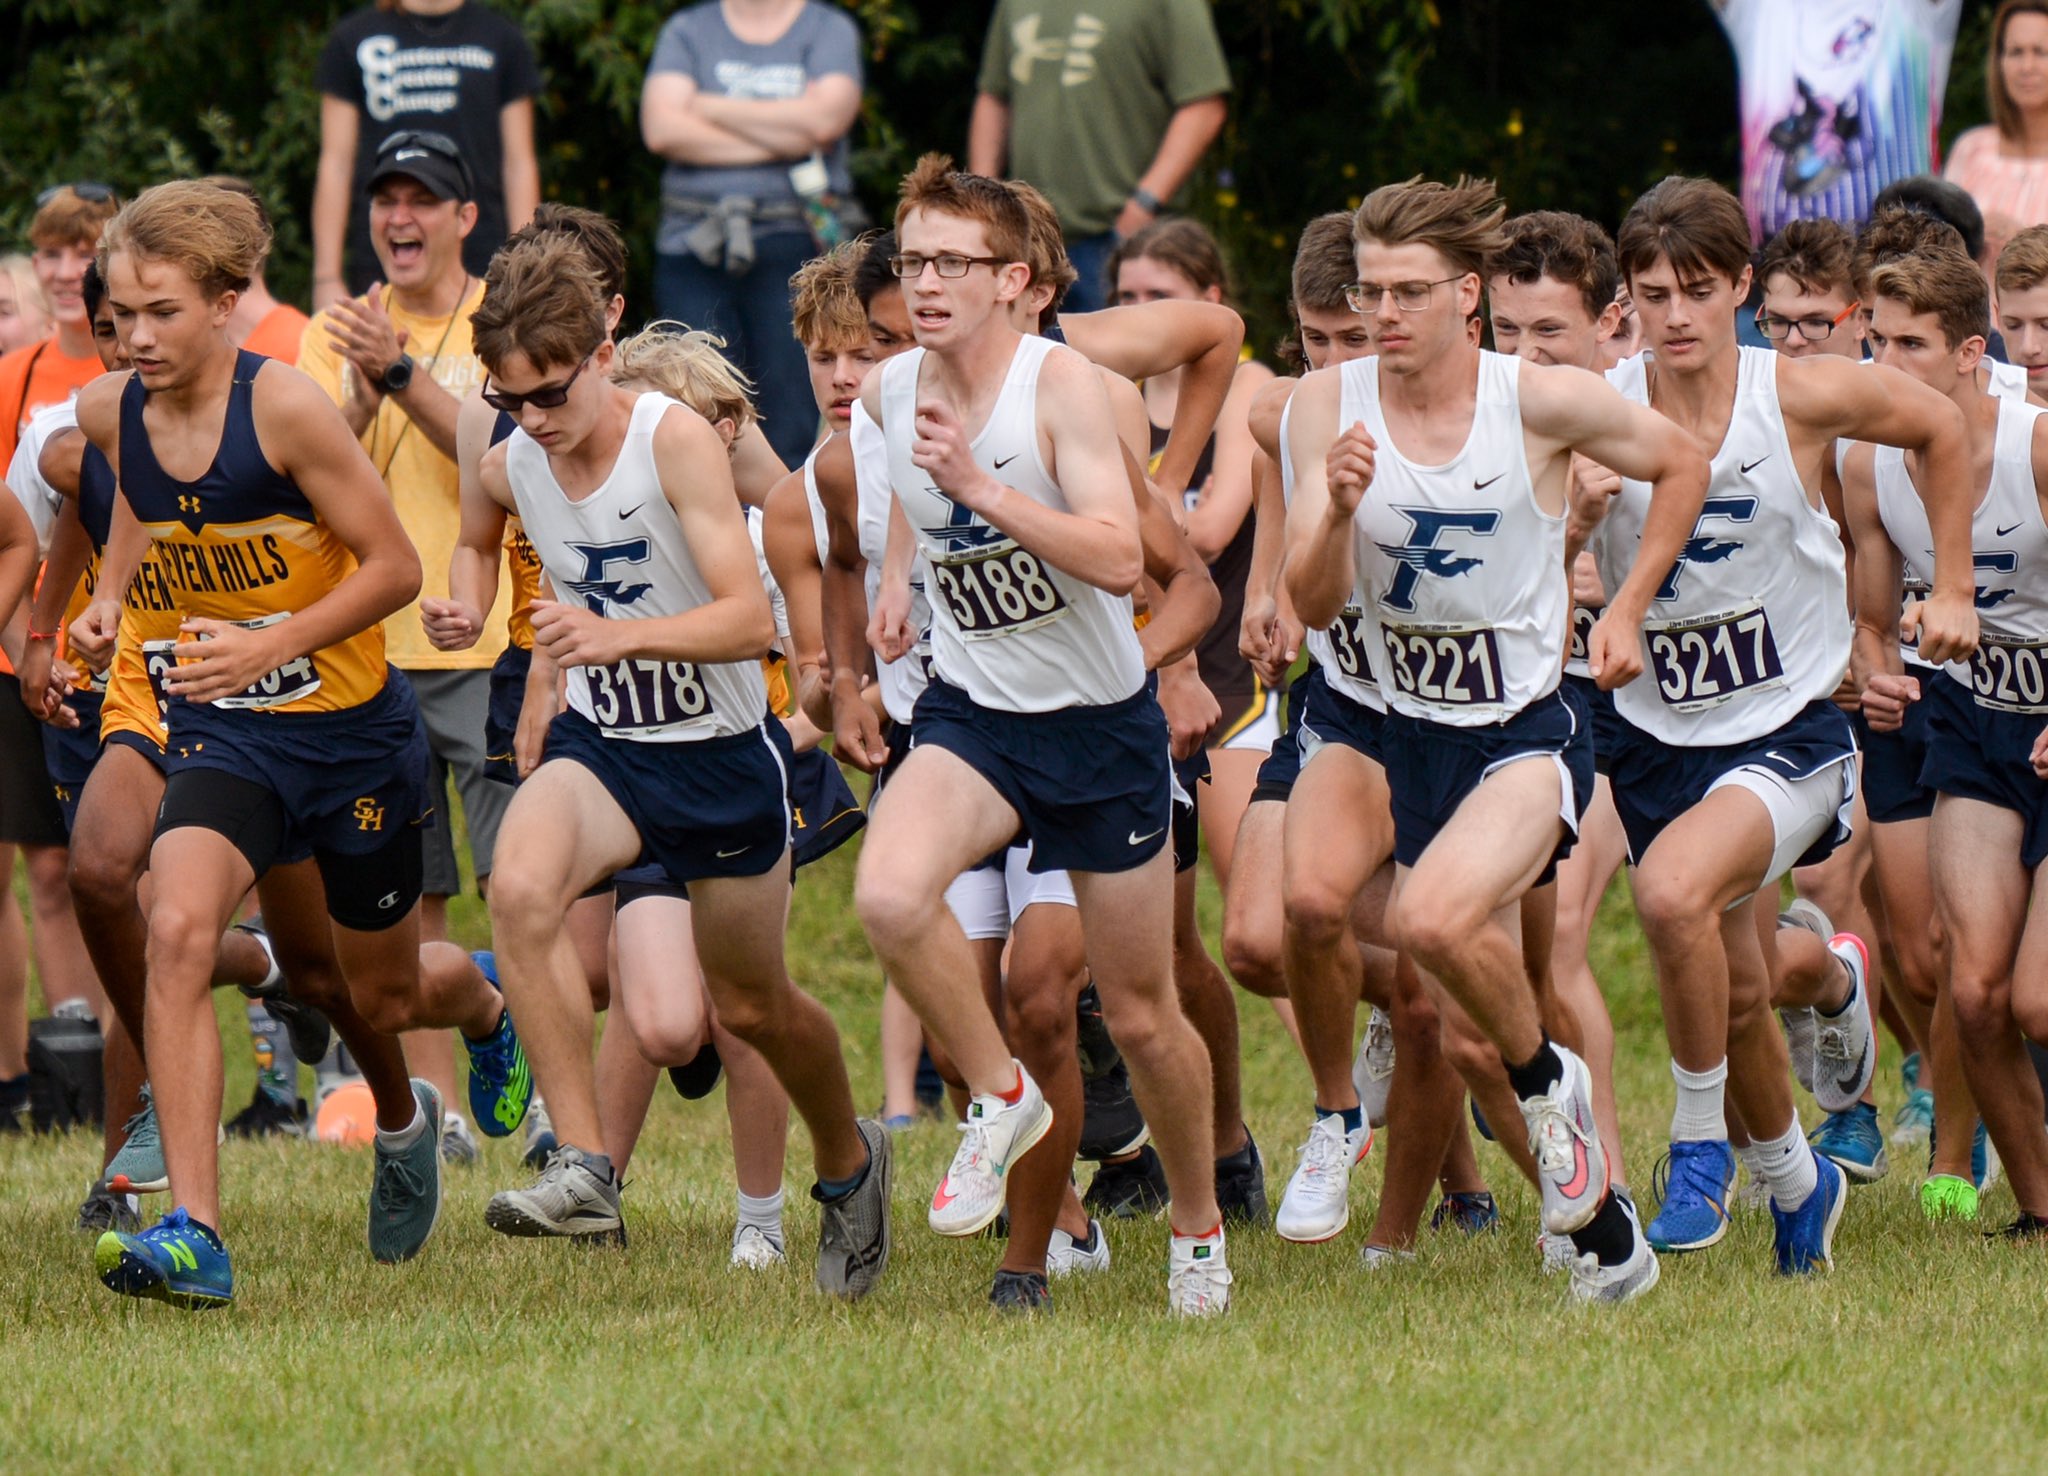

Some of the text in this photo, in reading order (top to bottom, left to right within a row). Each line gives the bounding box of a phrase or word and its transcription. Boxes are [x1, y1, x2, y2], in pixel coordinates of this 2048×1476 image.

[209, 534, 289, 592] HILLS
[936, 550, 1056, 628] 3188
[1386, 629, 1497, 701] 3221
[1652, 613, 1766, 701] 3217
[1974, 645, 2048, 704] 320
[587, 659, 705, 726] 3178
